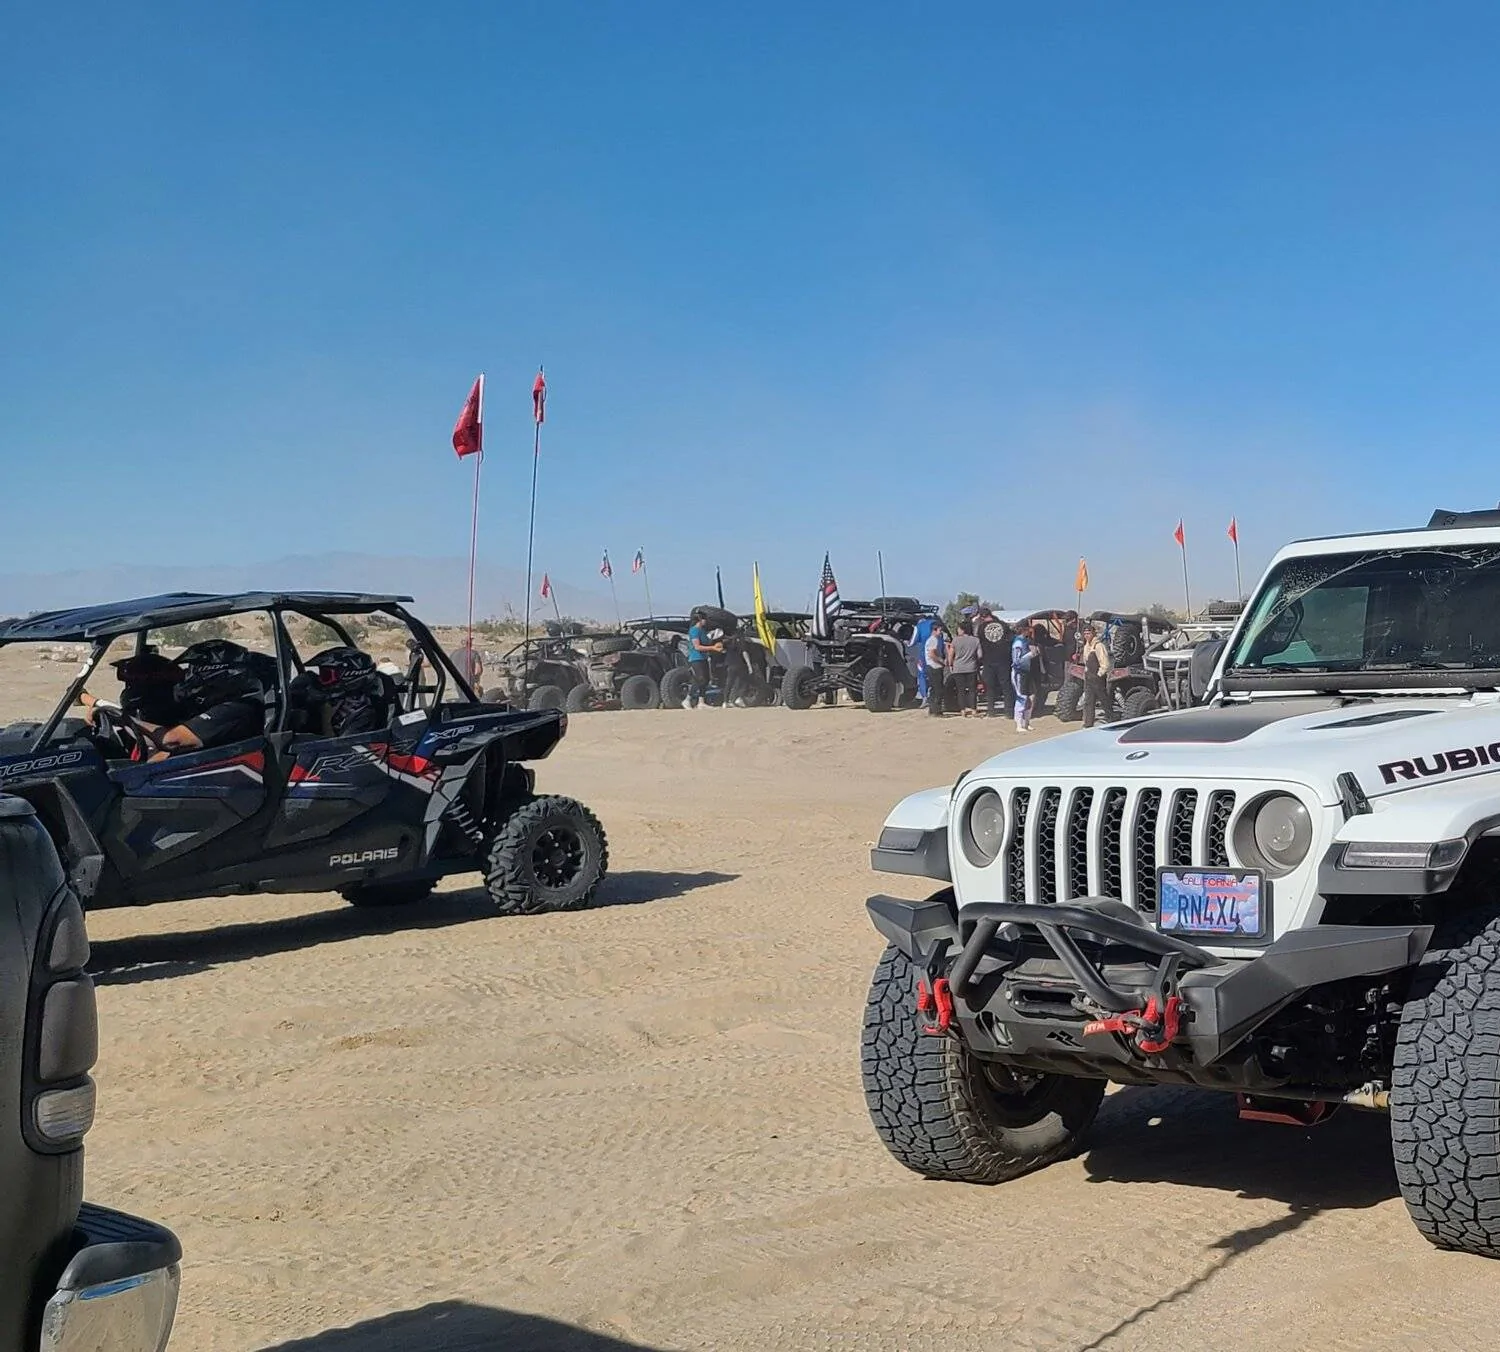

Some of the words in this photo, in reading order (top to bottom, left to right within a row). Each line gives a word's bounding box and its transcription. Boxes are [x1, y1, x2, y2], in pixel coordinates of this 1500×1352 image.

[329, 847, 399, 867] POLARIS
[1182, 876, 1238, 888] CALIFORNIA
[1178, 894, 1241, 925] RN4X4
